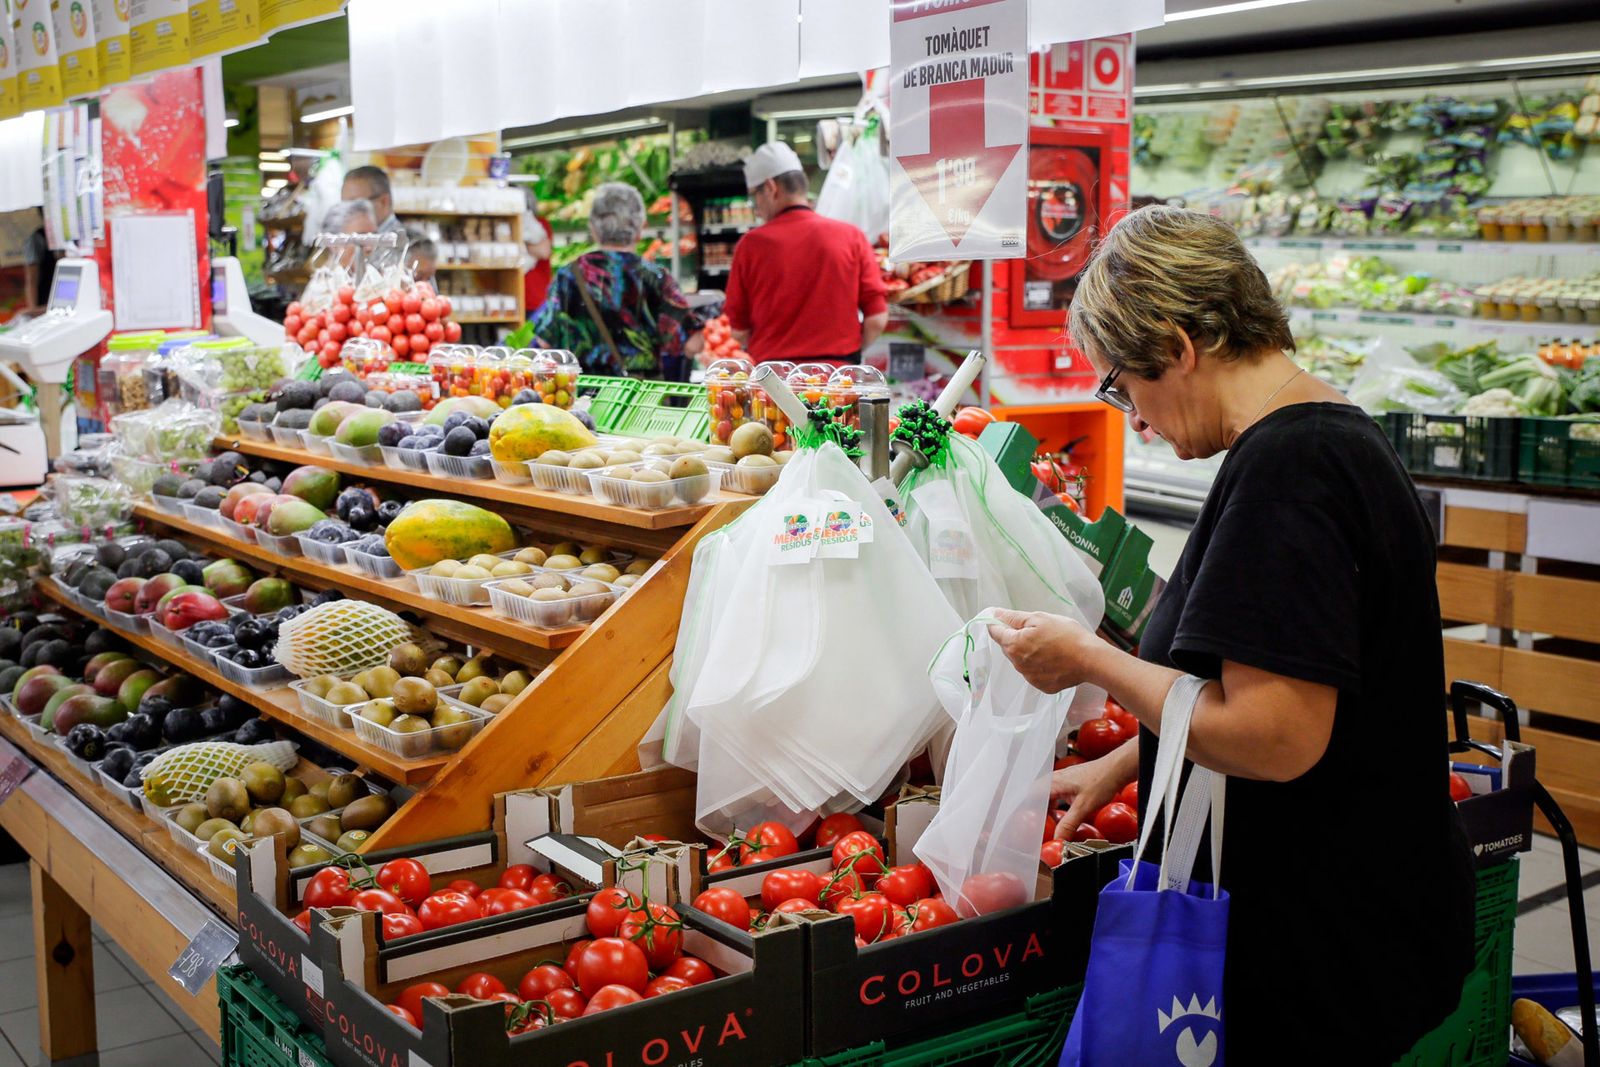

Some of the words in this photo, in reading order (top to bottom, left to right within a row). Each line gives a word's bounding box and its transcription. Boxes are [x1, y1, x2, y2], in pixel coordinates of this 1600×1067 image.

[925, 26, 991, 57] TOMÀQUET
[903, 68, 918, 89] DE
[920, 60, 968, 86] BRANCA
[970, 52, 1014, 79] MADUR
[780, 538, 813, 553] RESIDUS
[820, 534, 858, 546] RESIDUS
[1050, 511, 1070, 537] ROMA
[1069, 530, 1101, 557] DONNA
[1484, 834, 1523, 854] TOMATOES
[239, 911, 298, 979] COLOVA
[859, 931, 1045, 1006] COLOVA
[905, 994, 931, 1010] FRUIT
[934, 988, 953, 1001] AND
[956, 972, 1011, 996] VEGETABLES
